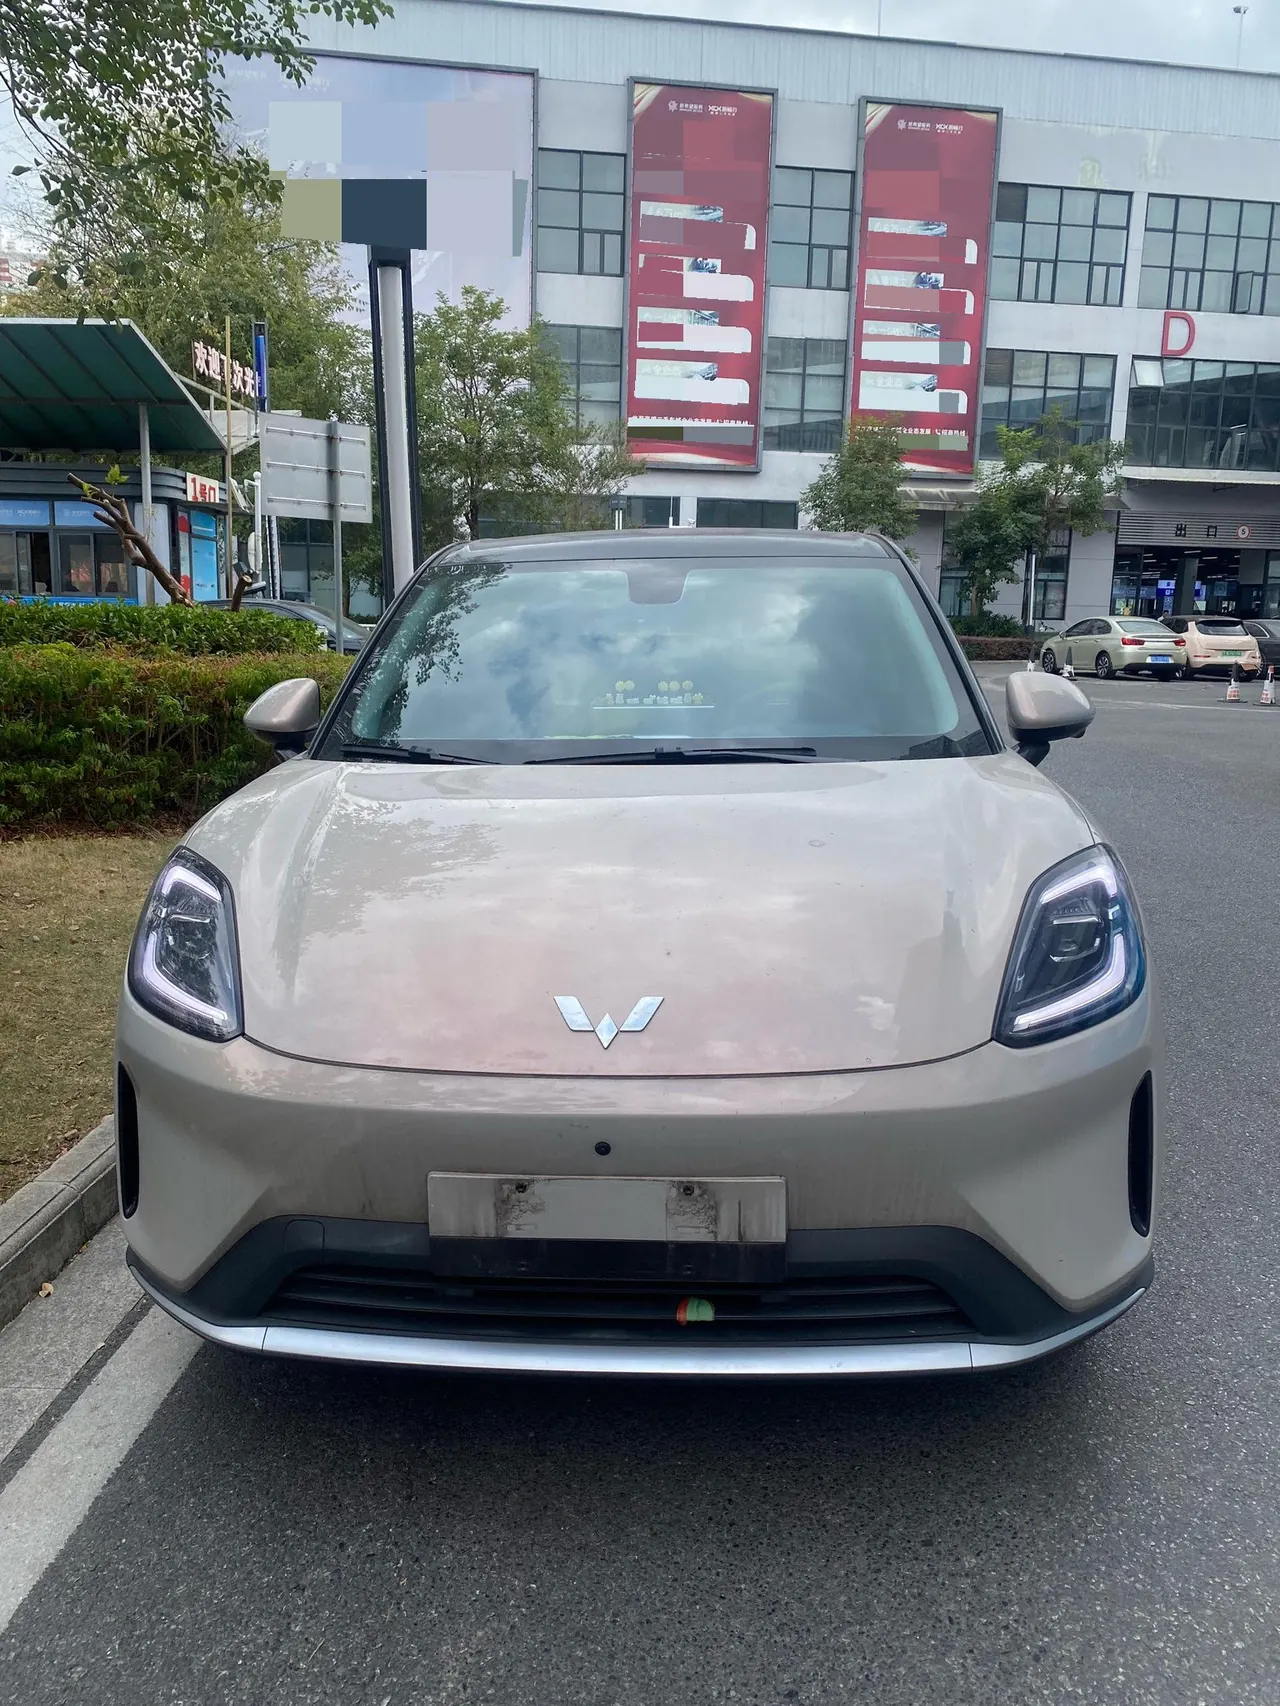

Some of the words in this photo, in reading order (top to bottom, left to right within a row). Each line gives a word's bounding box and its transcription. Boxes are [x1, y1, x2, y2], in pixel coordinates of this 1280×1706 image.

[1161, 310, 1196, 357] D
[191, 477, 216, 502] 1号门
[1174, 523, 1218, 538] 出口
